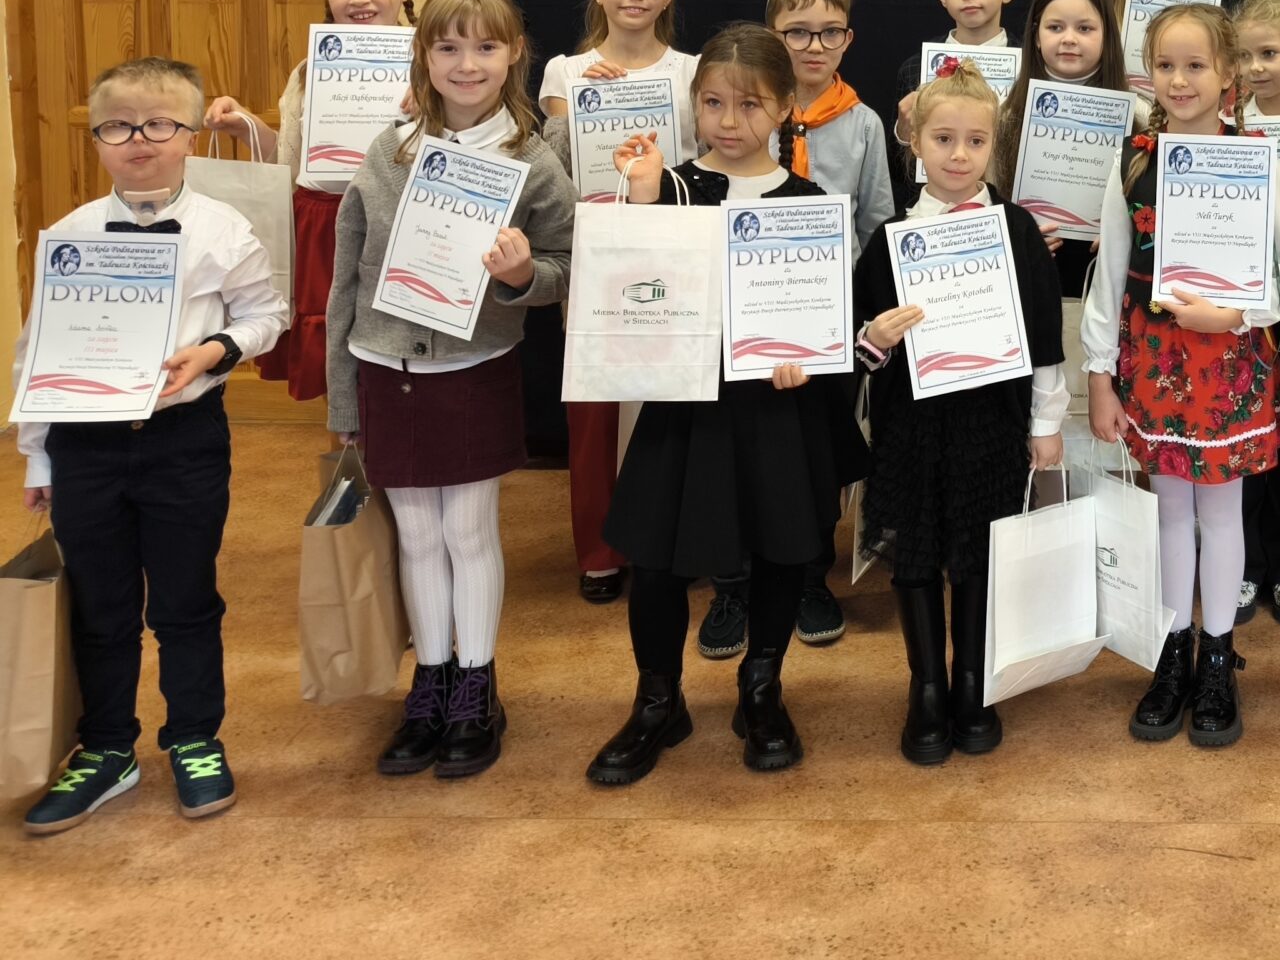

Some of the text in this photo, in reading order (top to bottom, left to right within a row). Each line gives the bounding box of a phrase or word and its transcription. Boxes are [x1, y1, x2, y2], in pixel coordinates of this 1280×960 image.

[318, 66, 409, 84] DYPLOM
[582, 114, 667, 134] DYPLOM
[1033, 124, 1118, 147] DYPLOM
[1168, 181, 1262, 201] DYPLOM
[412, 186, 499, 225] DYPLOM
[735, 244, 837, 266] DYPLOM
[907, 255, 1001, 286] DYPLOM
[49, 284, 167, 303] DYPLOM
[747, 278, 784, 289] Antoniny
